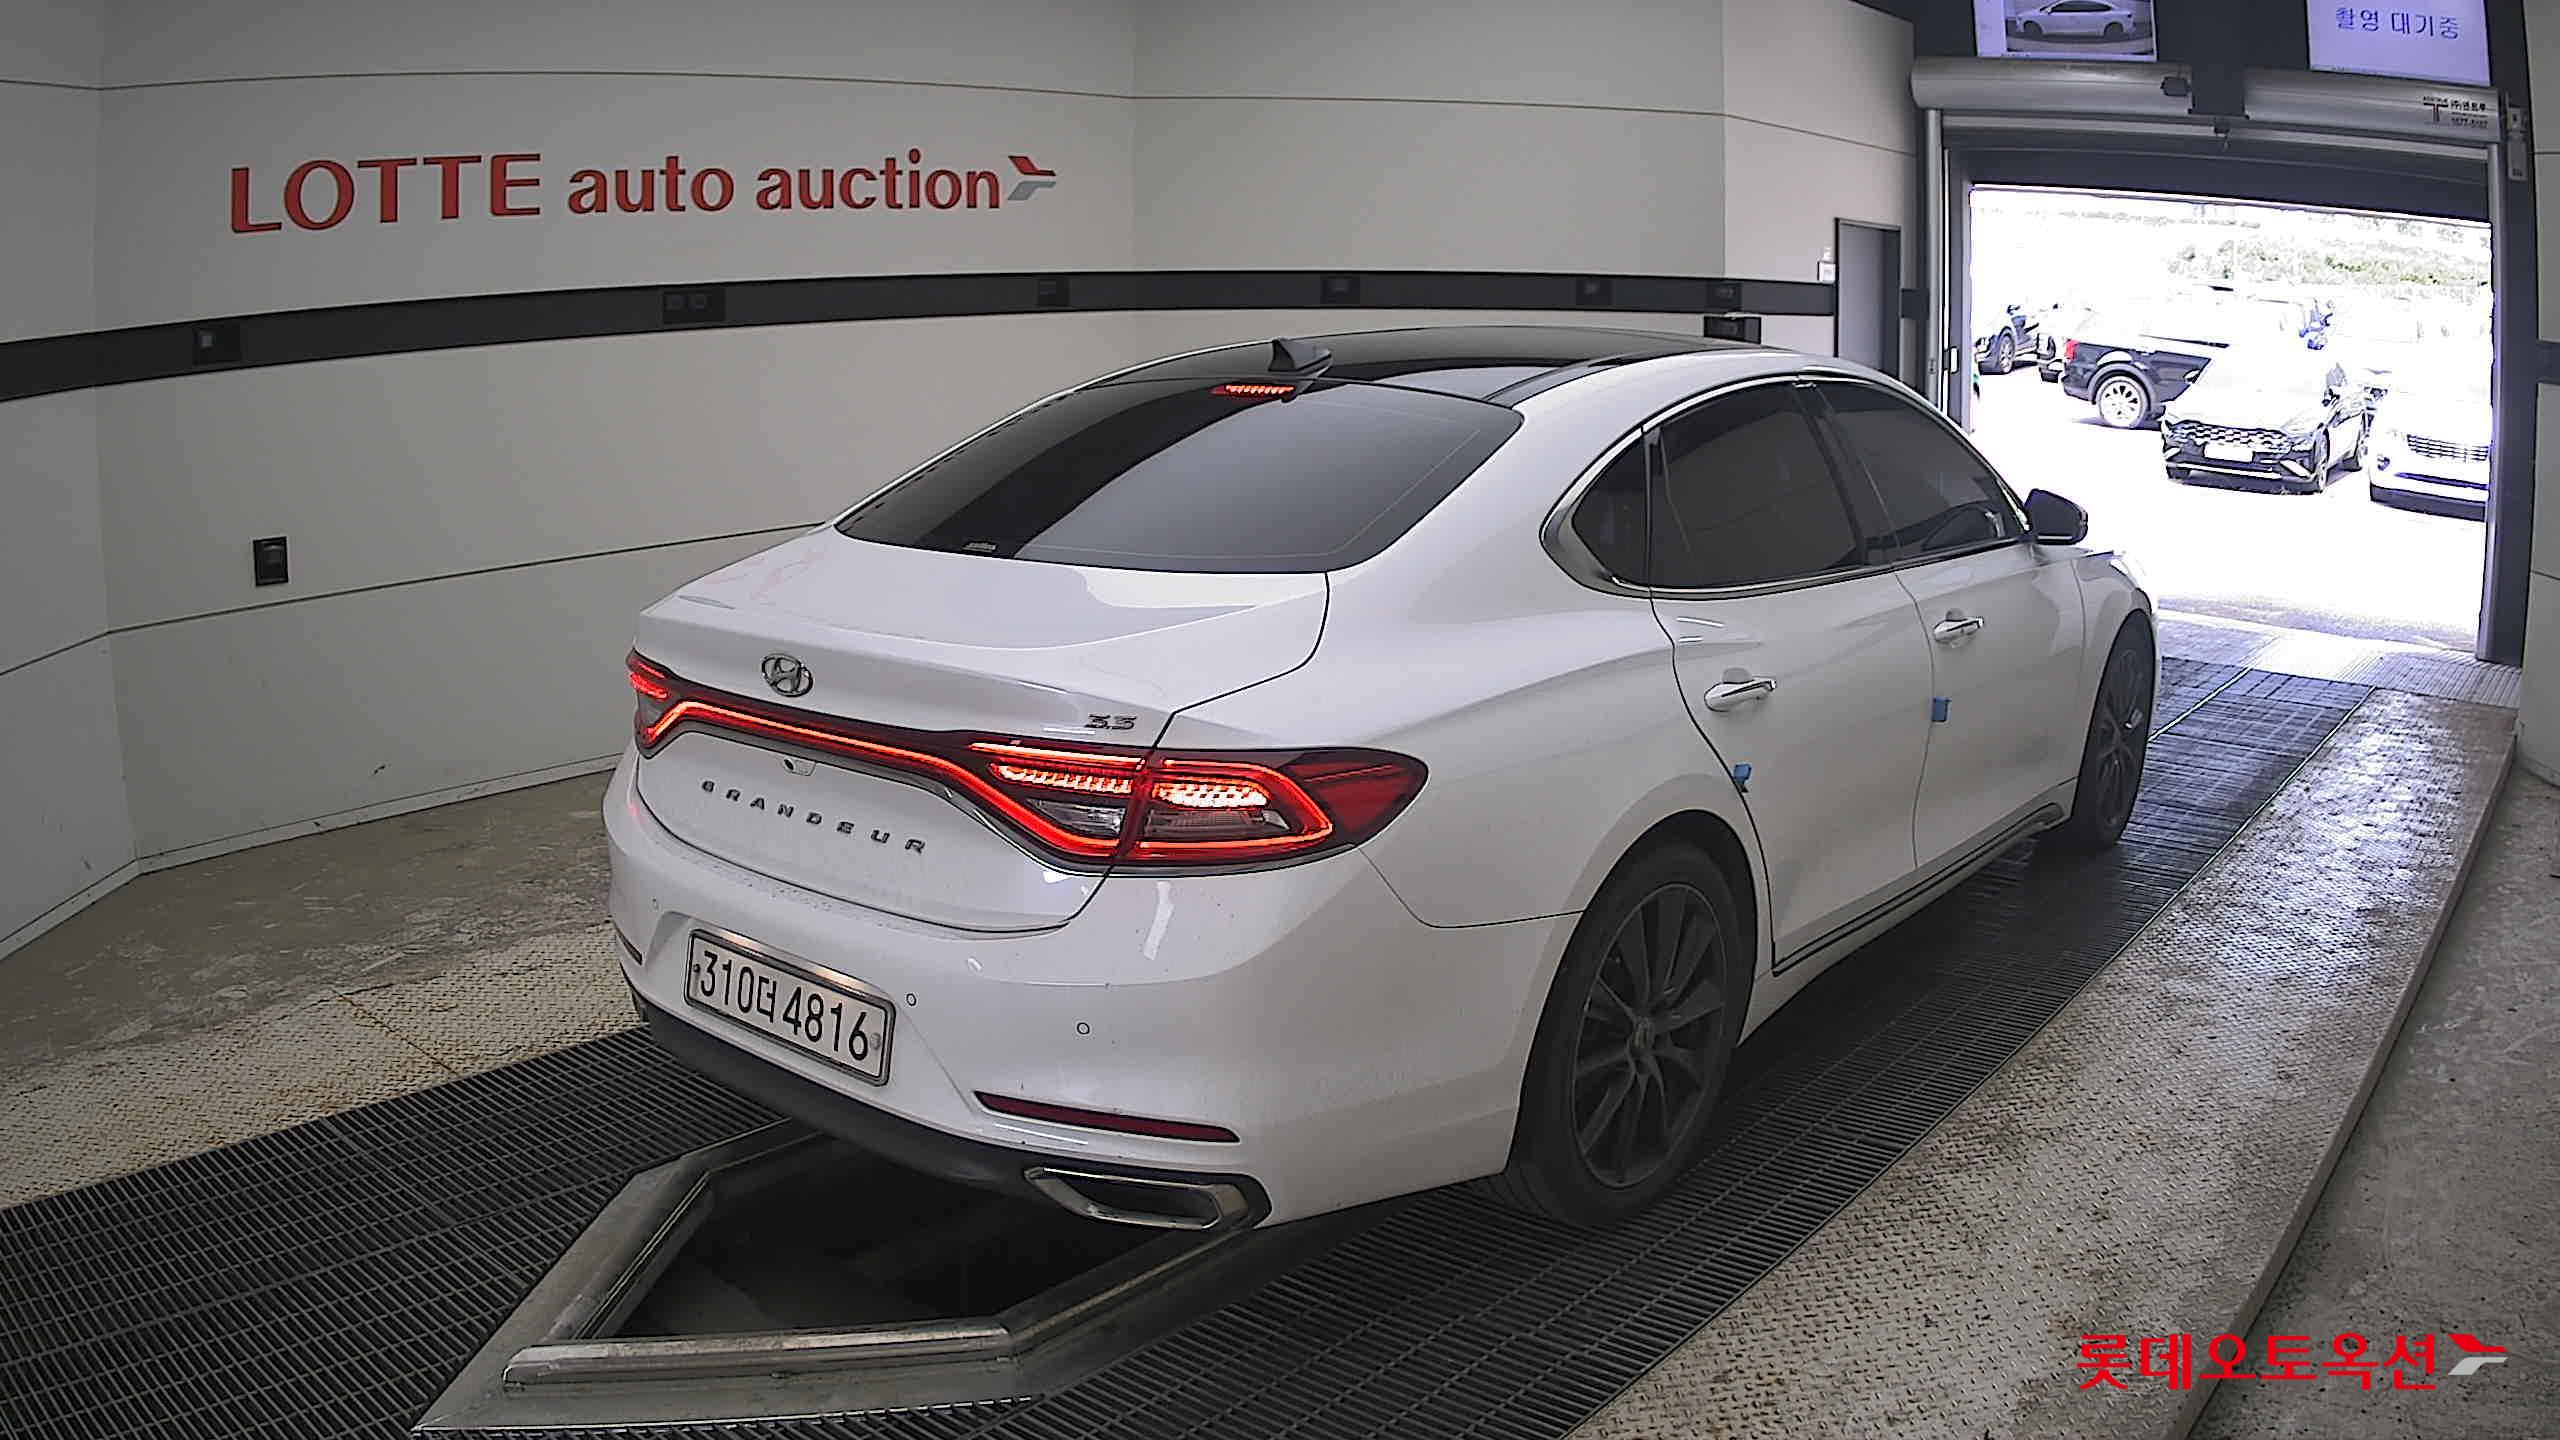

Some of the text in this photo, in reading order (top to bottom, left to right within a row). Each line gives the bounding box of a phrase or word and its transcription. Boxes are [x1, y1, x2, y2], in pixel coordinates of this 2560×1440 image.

[2336, 7, 2459, 39] 촬영 대기중
[230, 148, 1001, 234] LOTTE auto auction
[701, 780, 926, 855] GRANDEUR
